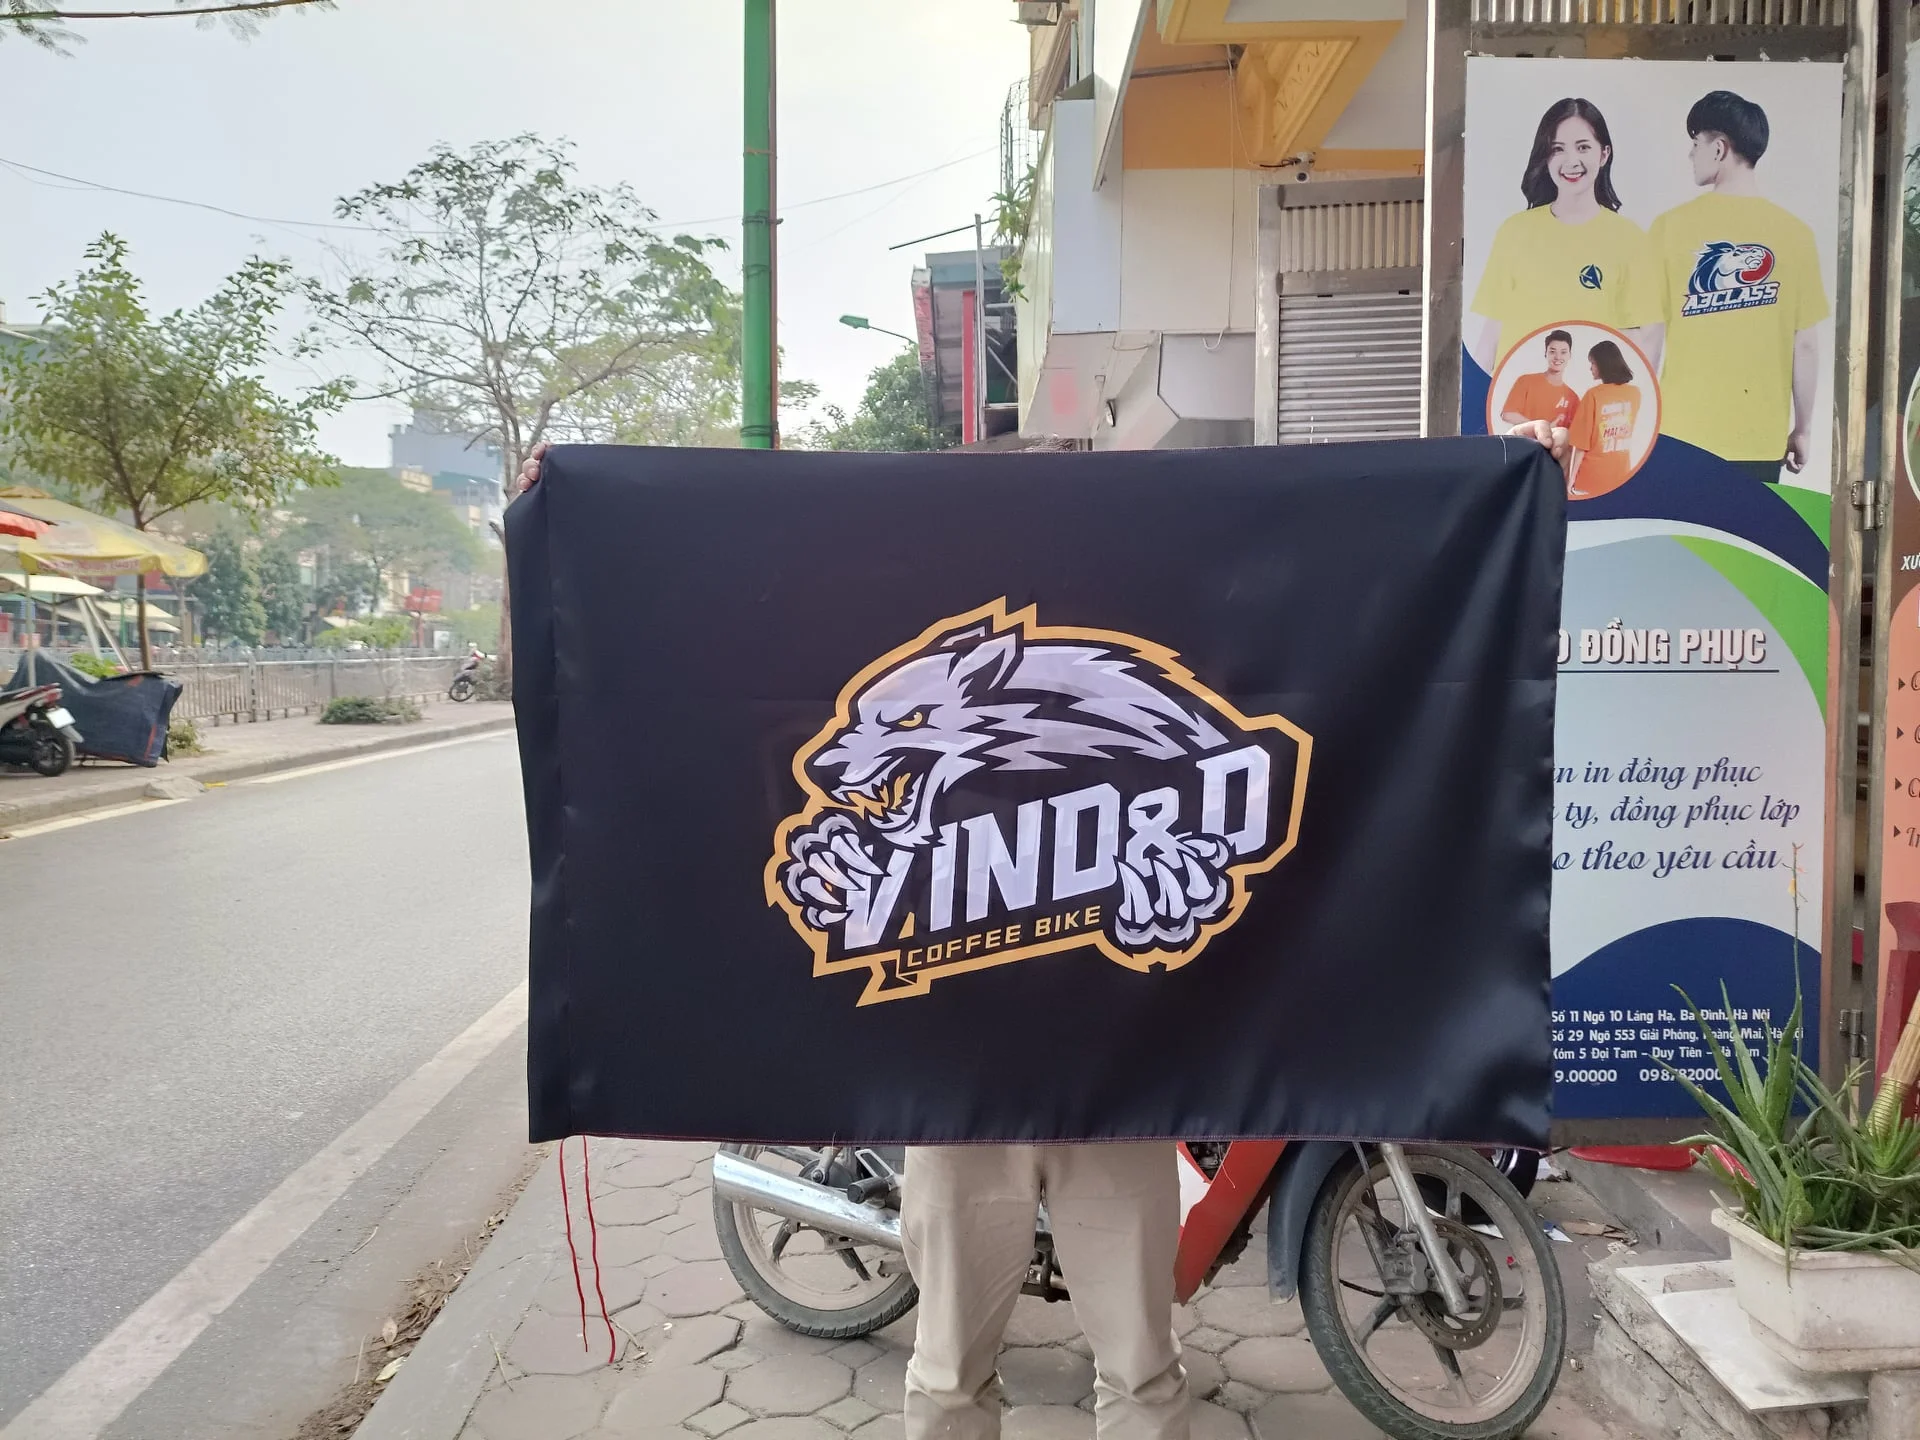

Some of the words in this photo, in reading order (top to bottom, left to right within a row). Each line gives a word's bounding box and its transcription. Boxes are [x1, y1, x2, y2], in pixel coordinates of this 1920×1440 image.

[1580, 617, 1670, 664] ĐỒNG
[1680, 629, 1766, 671] PHỤC
[1583, 761, 1614, 783] in
[1618, 757, 1688, 790] đồng
[1692, 757, 1763, 790] phục
[1565, 801, 1599, 829] ty,
[1610, 795, 1680, 829] đồng
[1684, 795, 1755, 828] phục
[1760, 795, 1800, 828] lớp
[1581, 840, 1650, 870] theo
[1652, 845, 1716, 879] yêu
[1721, 839, 1782, 869] cầu
[907, 923, 1023, 967] COFFEE
[1035, 905, 1102, 938] BIKE
[1551, 1009, 1566, 1022] Số
[1569, 1010, 1579, 1022] 11
[1583, 1010, 1605, 1024] Ngõ
[1609, 1010, 1623, 1022] 10
[1627, 1009, 1654, 1024] Láng
[1680, 1009, 1695, 1021] Ba
[1733, 1008, 1748, 1020] Hà
[1568, 1030, 1584, 1042] 29
[1589, 1029, 1610, 1044] Ngõ
[1614, 1029, 1635, 1041] 553
[1639, 1028, 1659, 1041] Giải
[1741, 1028, 1764, 1040] Mai,
[1579, 1047, 1587, 1059] 5
[1591, 1047, 1609, 1062] Đọi
[1613, 1047, 1637, 1059] Tam
[1652, 1046, 1674, 1061] Duy
[1679, 1046, 1702, 1058] Tiên
